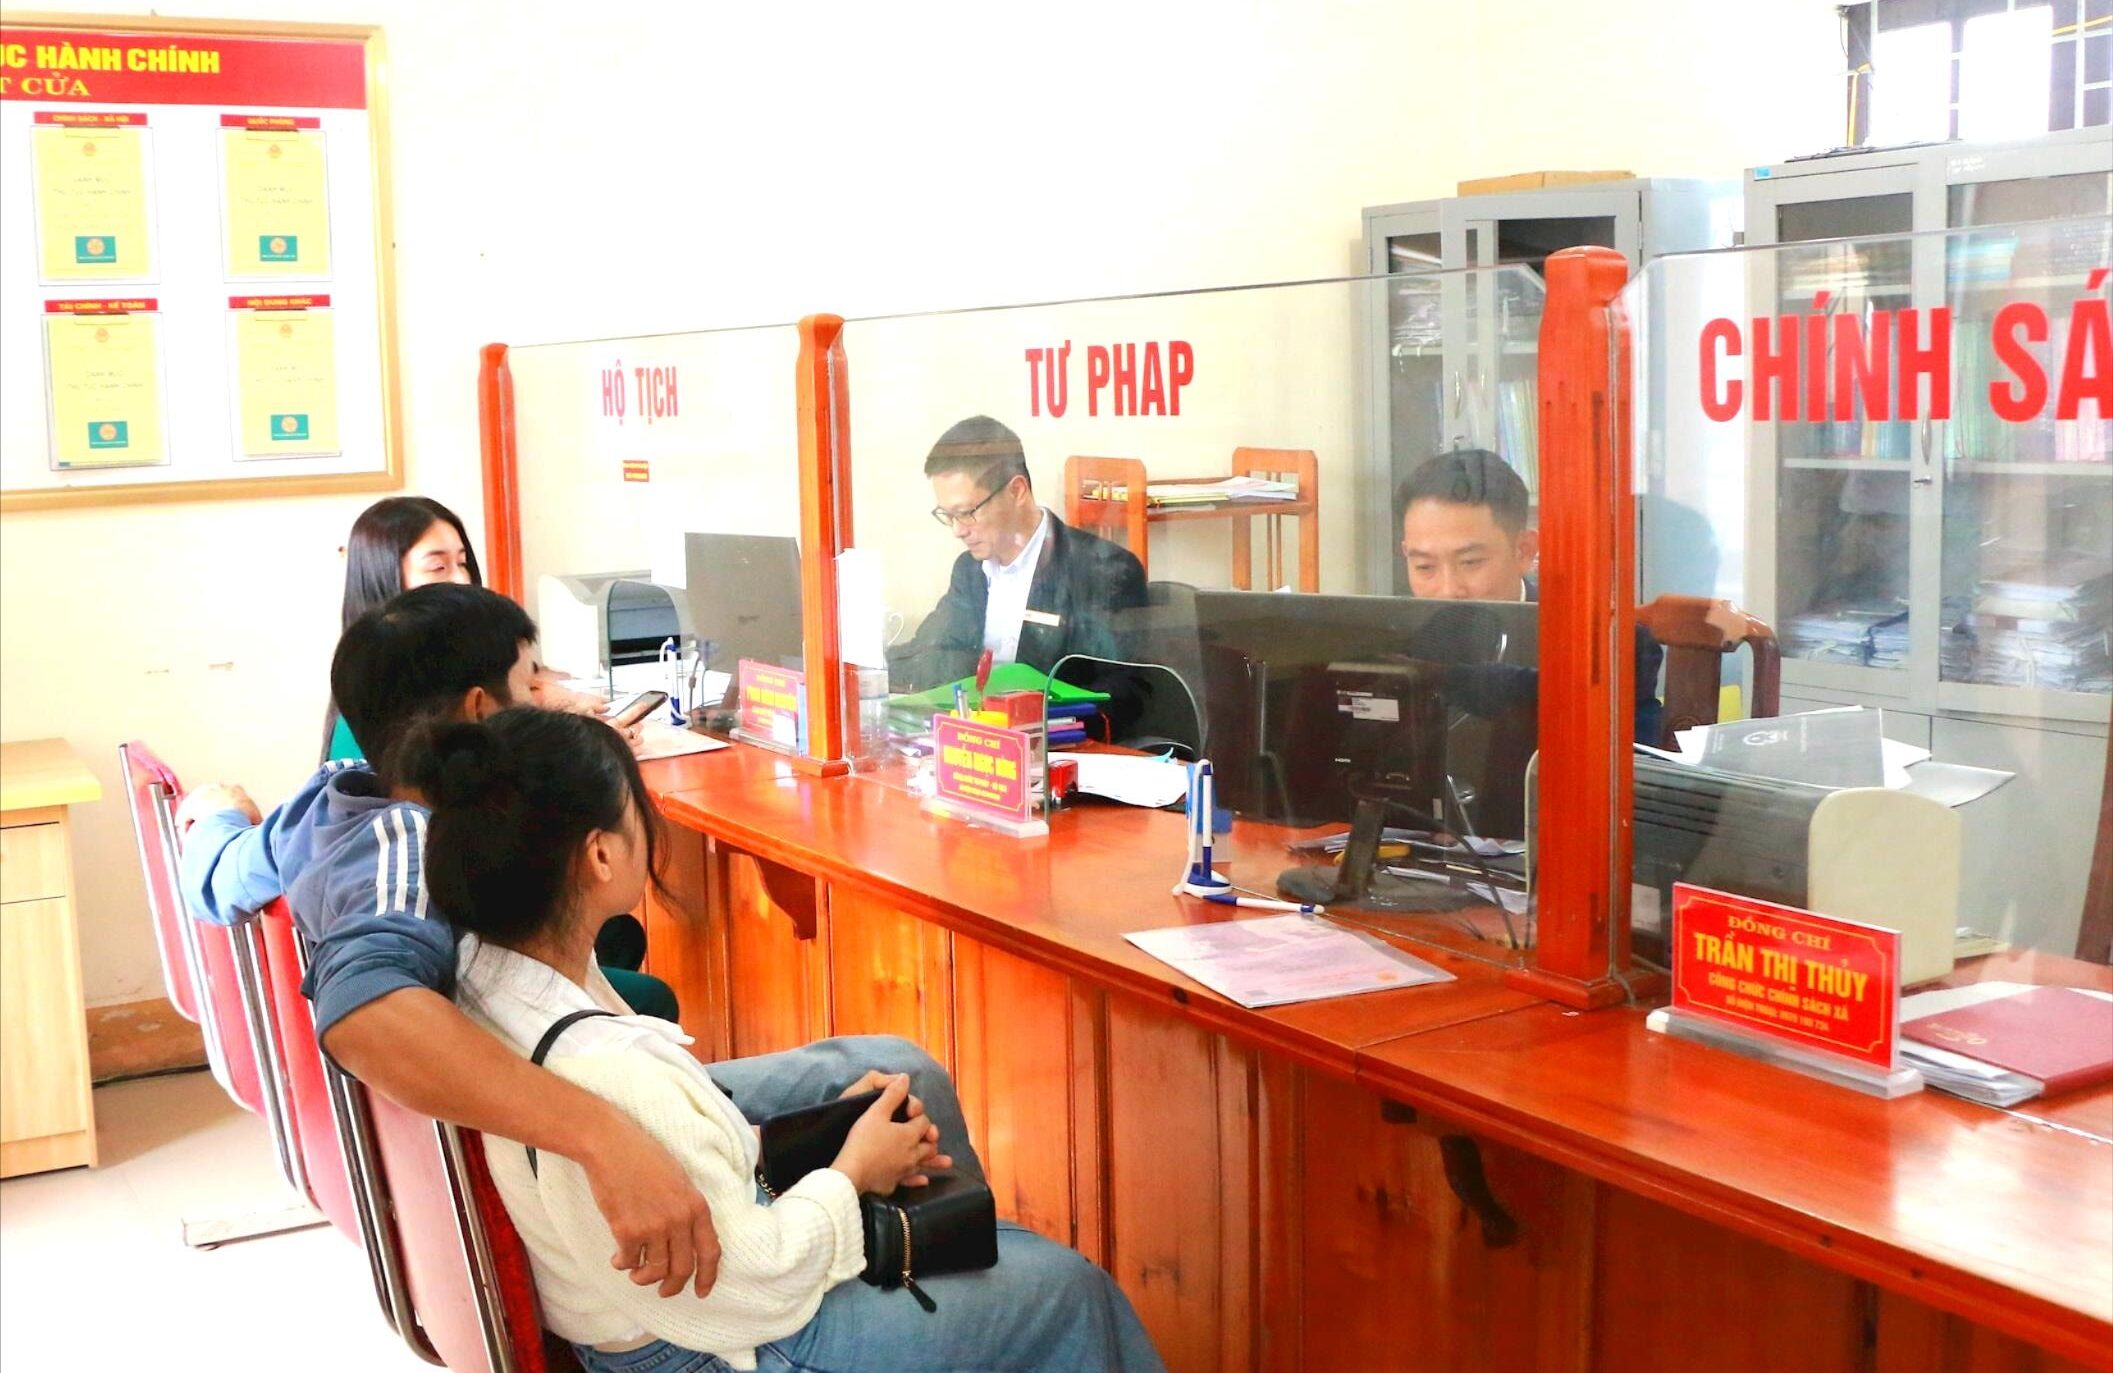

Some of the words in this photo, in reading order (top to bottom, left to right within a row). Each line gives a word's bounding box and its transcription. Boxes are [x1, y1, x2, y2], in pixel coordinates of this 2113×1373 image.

[0, 44, 27, 68] C
[36, 41, 121, 71] HÀNH
[127, 45, 220, 73] CHÍNH
[21, 71, 90, 96] CỬA
[1024, 339, 1071, 418] TƯ
[1087, 340, 1194, 417] PHAP
[1698, 291, 1953, 423] CHÍNH
[602, 358, 625, 426] HỘ
[635, 366, 678, 424] TỊCH
[1693, 930, 1755, 974] TRẦN
[1760, 948, 1798, 991] THỊ
[1804, 957, 1869, 1003] THỦY
[1791, 931, 1831, 951] CHÍ
